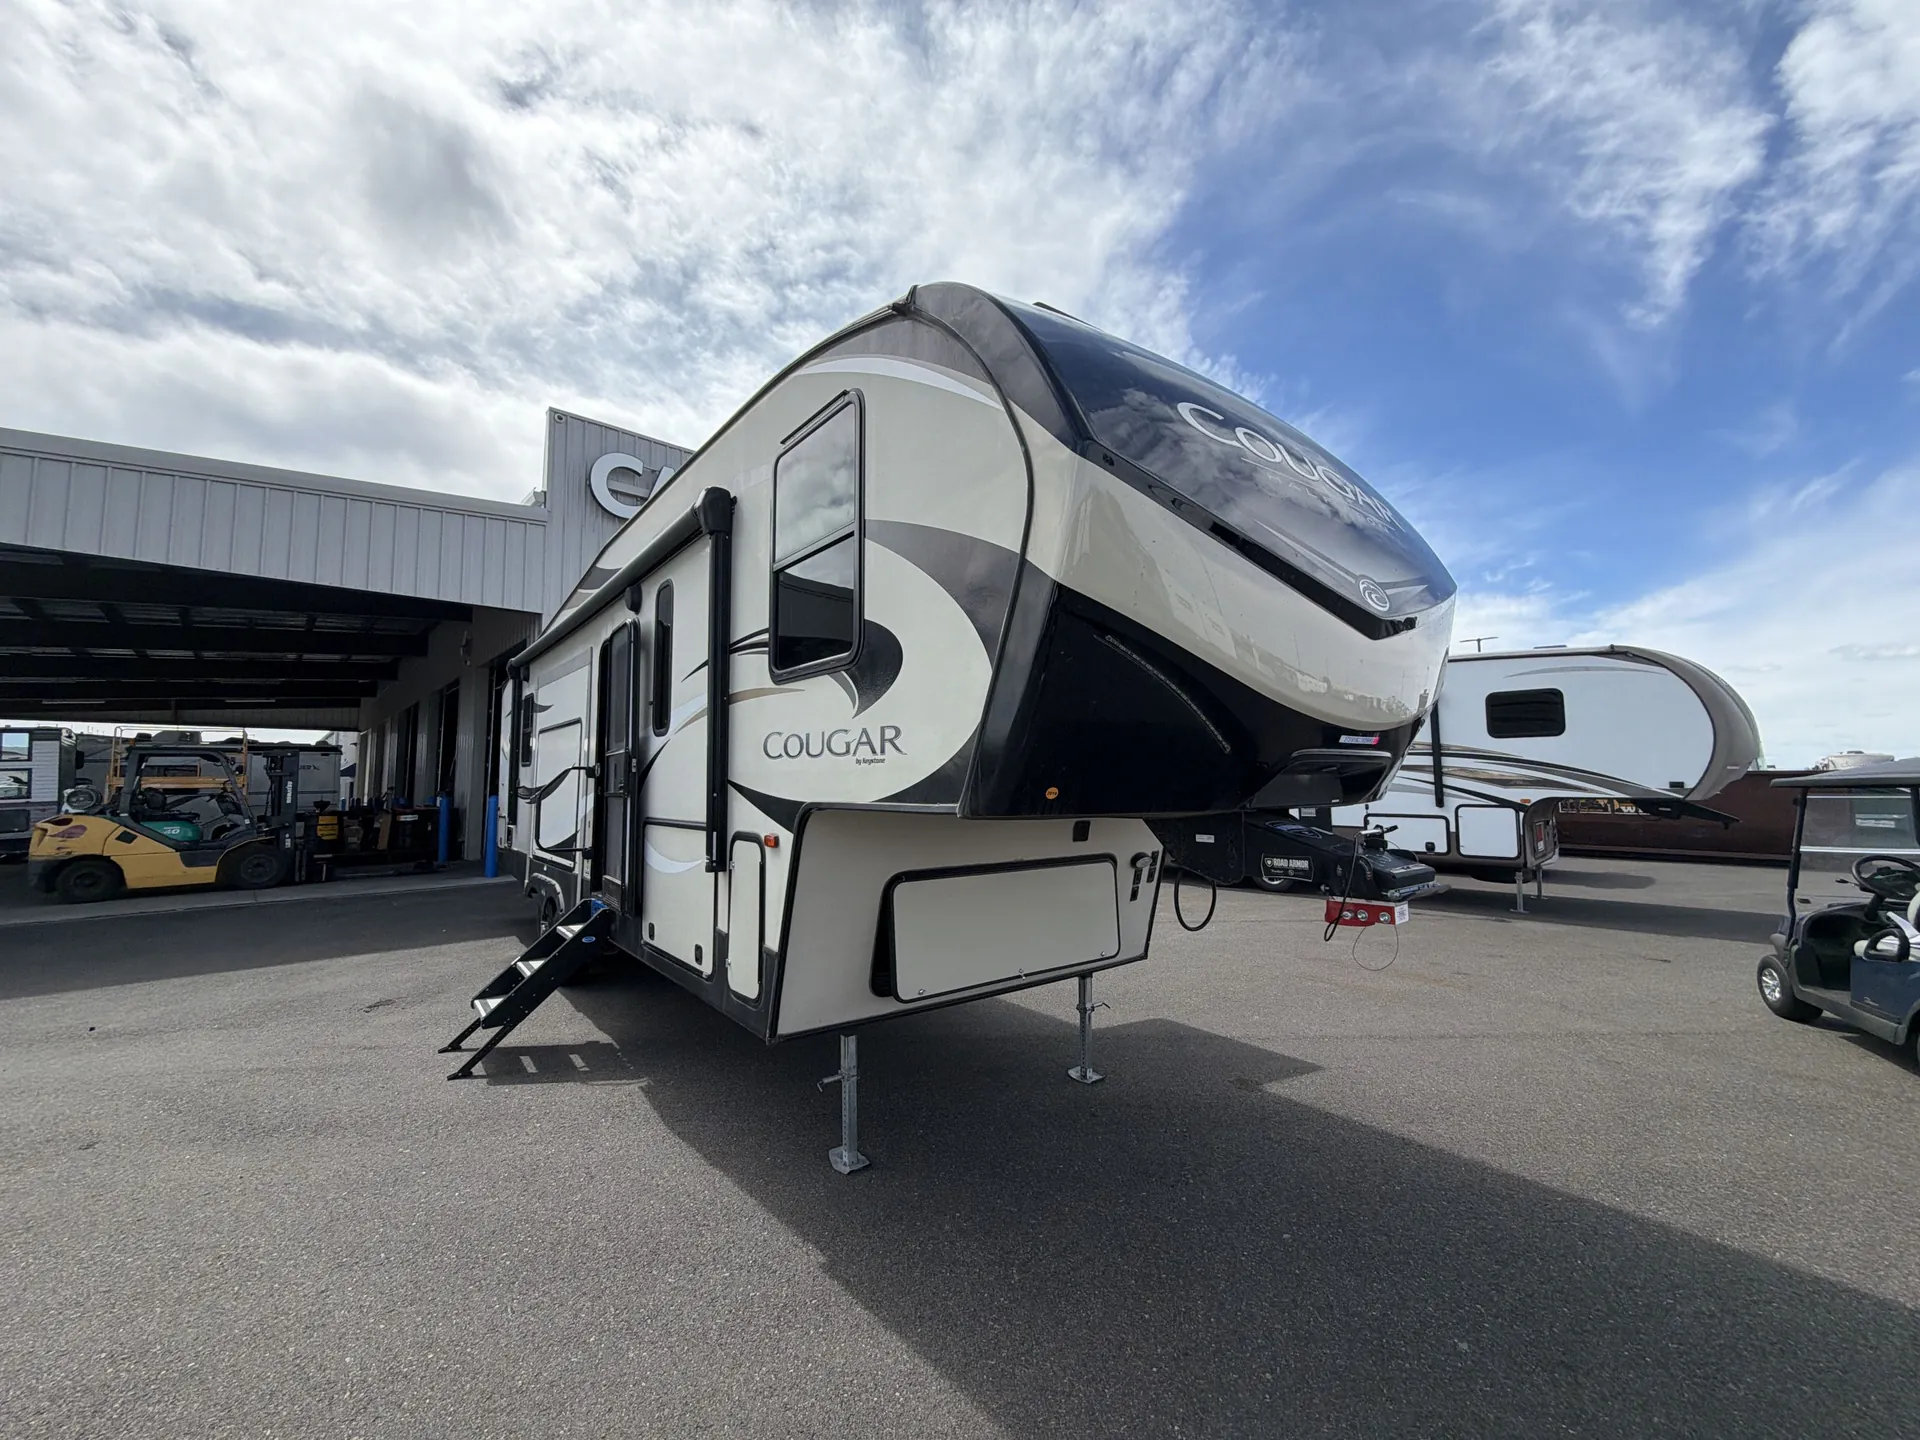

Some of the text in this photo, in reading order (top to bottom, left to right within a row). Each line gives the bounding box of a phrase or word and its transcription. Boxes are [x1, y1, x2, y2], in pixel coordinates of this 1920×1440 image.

[1177, 402, 1405, 533] COUGAR
[763, 725, 907, 760] COUGAR
[862, 757, 886, 765] Keystone
[1274, 858, 1309, 869] ROAD ARMOR
